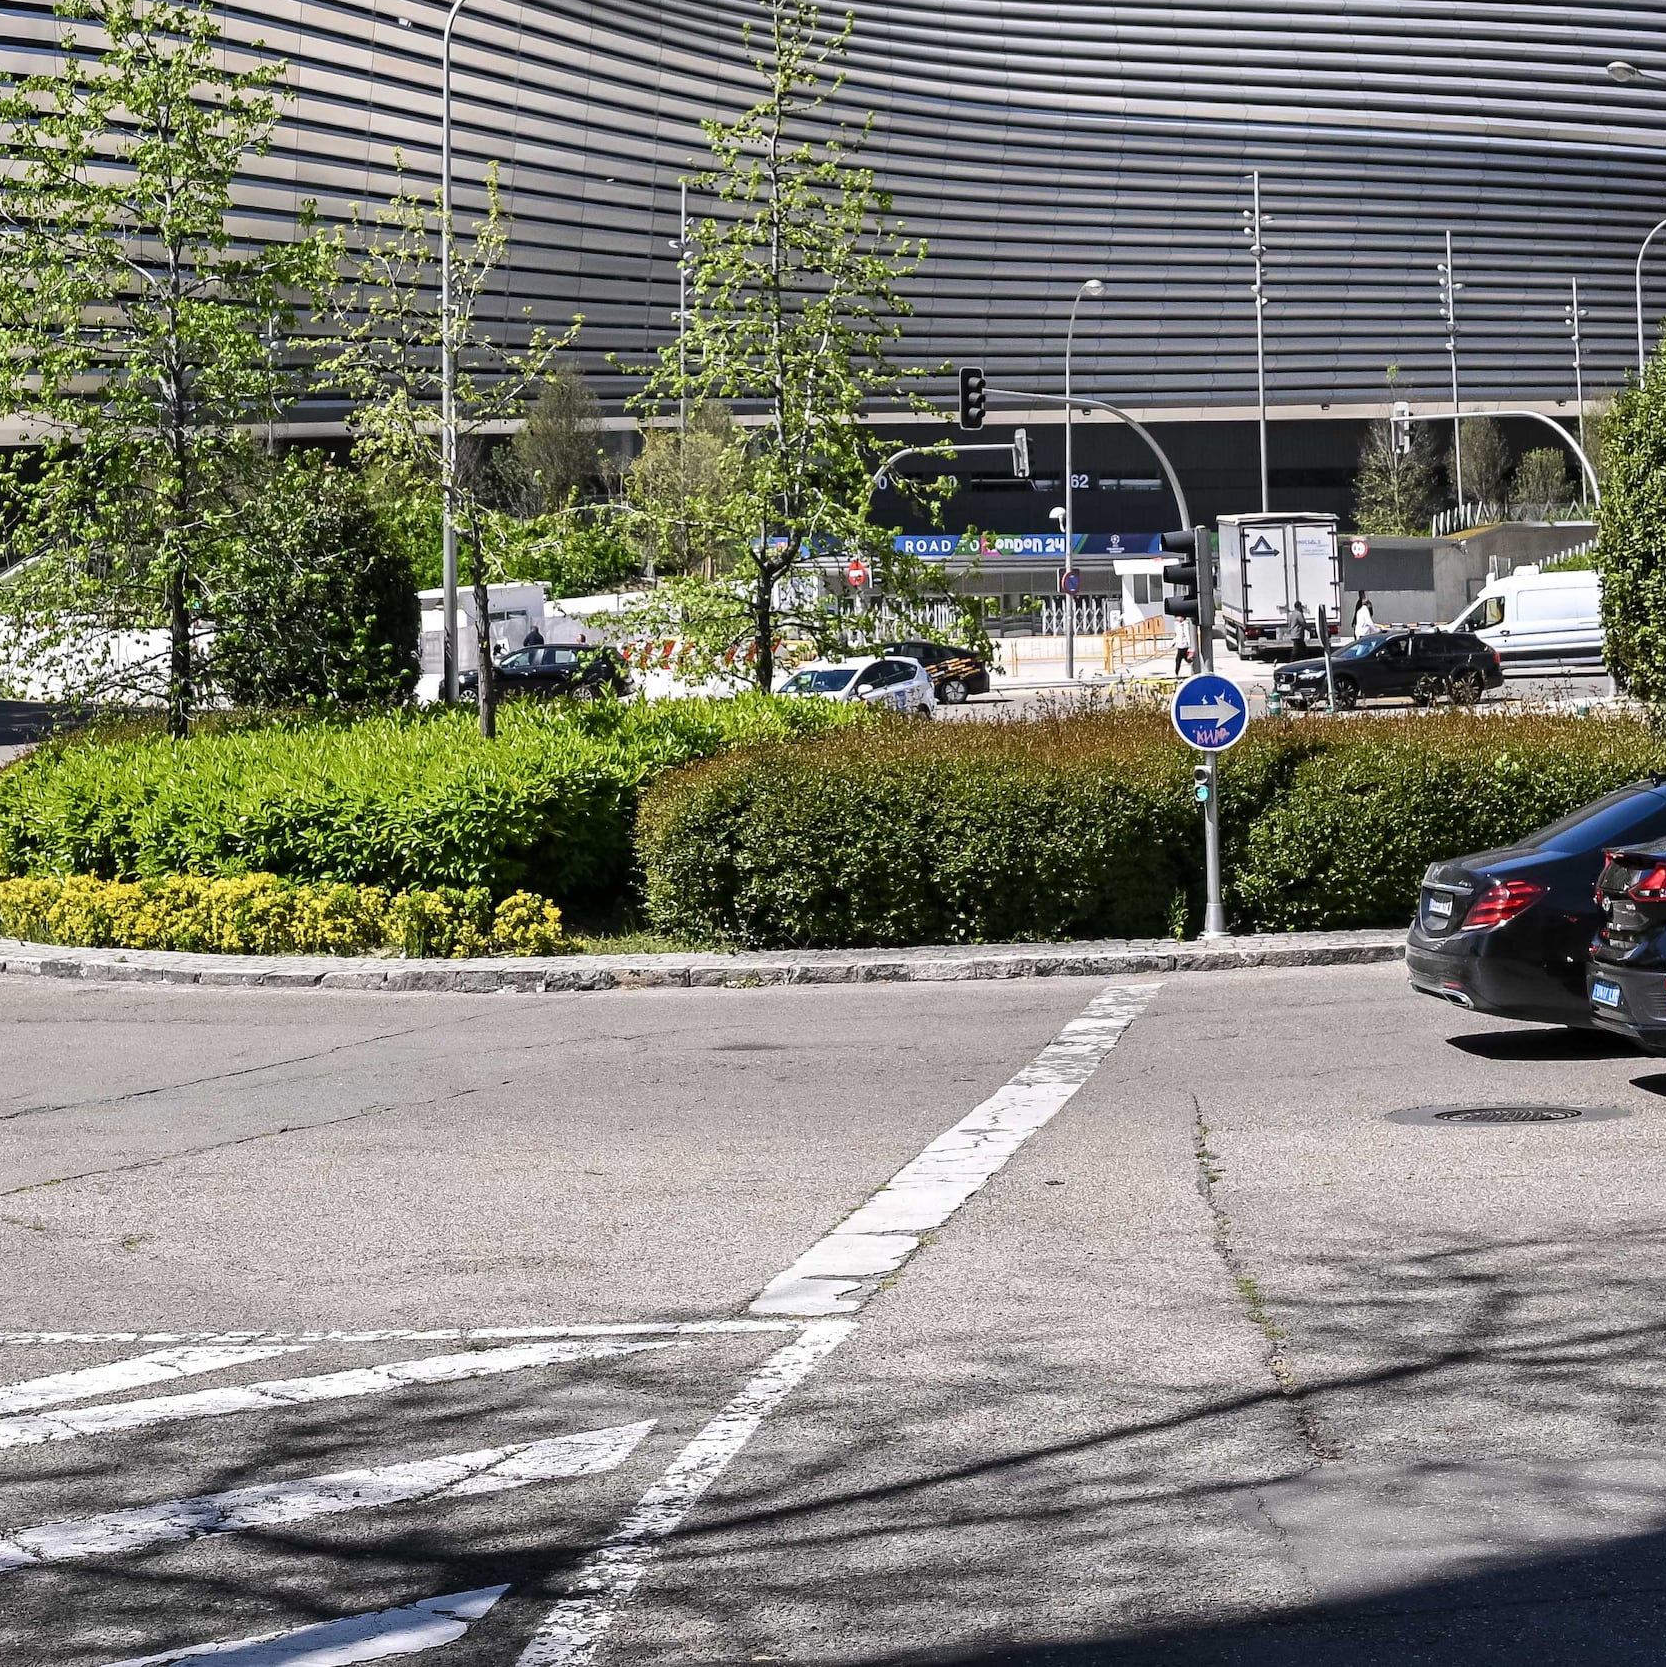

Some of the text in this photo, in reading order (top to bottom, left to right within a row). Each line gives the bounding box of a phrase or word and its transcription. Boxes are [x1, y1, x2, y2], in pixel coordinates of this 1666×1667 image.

[1070, 474, 1089, 489] 62
[904, 539, 952, 553] ROAD
[1044, 537, 1065, 553] 24
